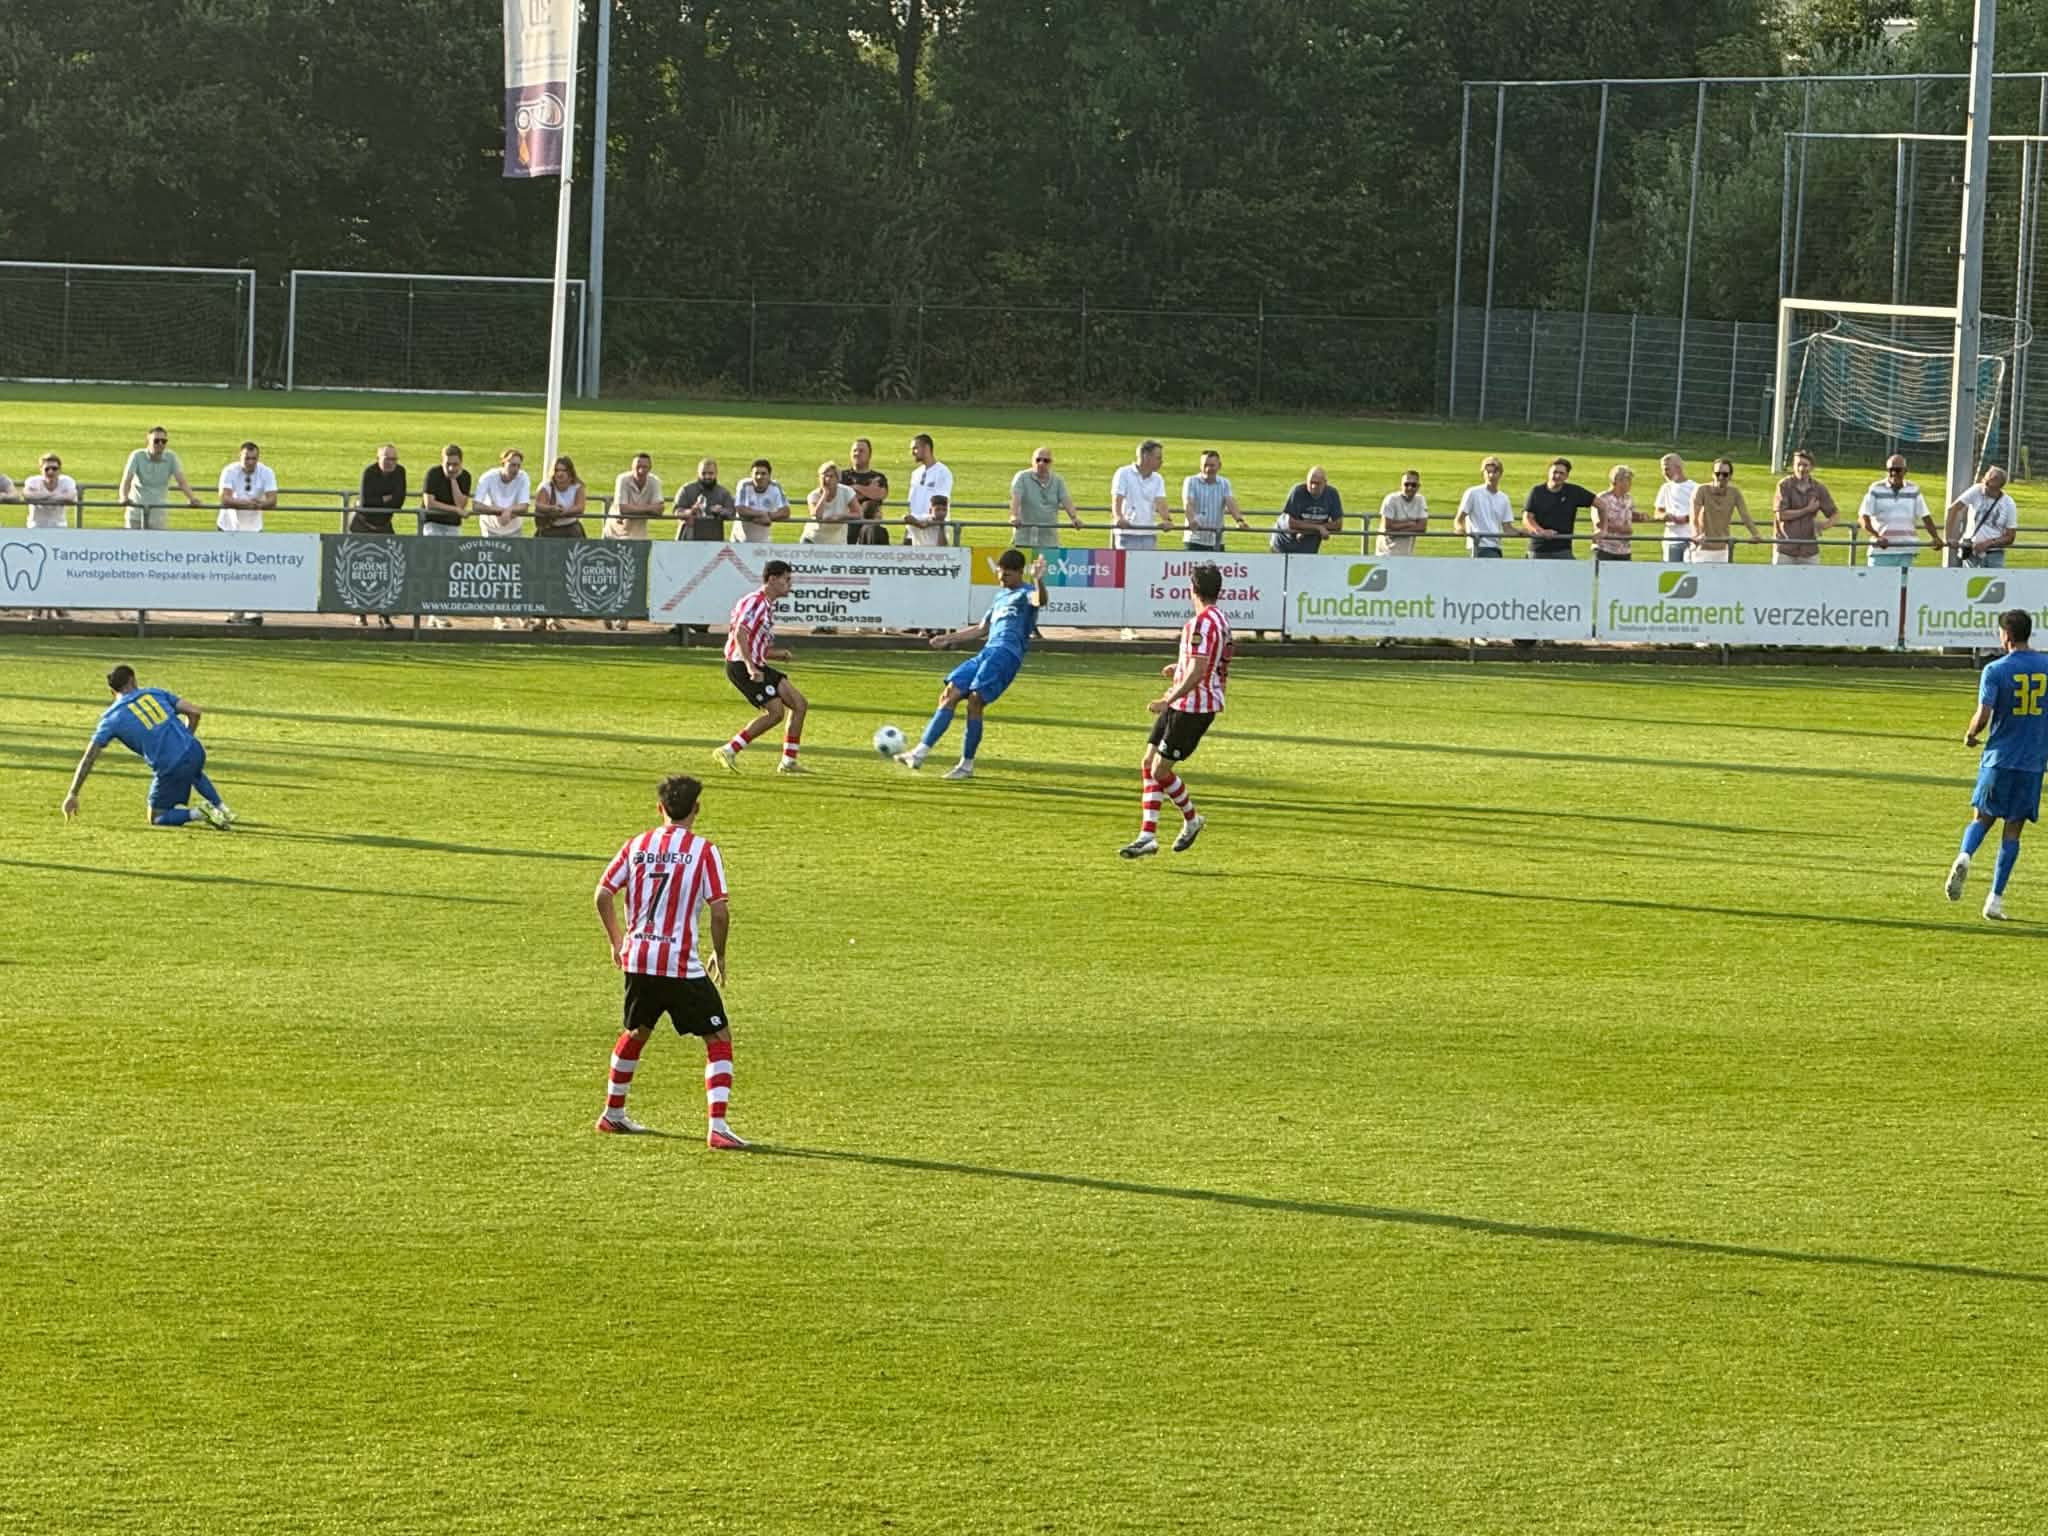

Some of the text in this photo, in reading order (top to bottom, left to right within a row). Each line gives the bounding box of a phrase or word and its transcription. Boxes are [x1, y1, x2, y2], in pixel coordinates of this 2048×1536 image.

[52, 547, 304, 569] Tandprothetische praktijk Dentray
[478, 551, 494, 562] DE
[449, 562, 522, 581] GROENE
[831, 564, 848, 575] en
[448, 581, 523, 599] BELOFTE
[1149, 583, 1165, 600] is
[1169, 586, 1192, 600] on
[794, 600, 847, 616] bruijn
[1297, 591, 1581, 625] fundament hypotheken
[1608, 599, 1889, 631] fundament verzekeren
[2012, 673, 2047, 716] 32
[127, 693, 169, 731] 10
[648, 872, 670, 922] 7
